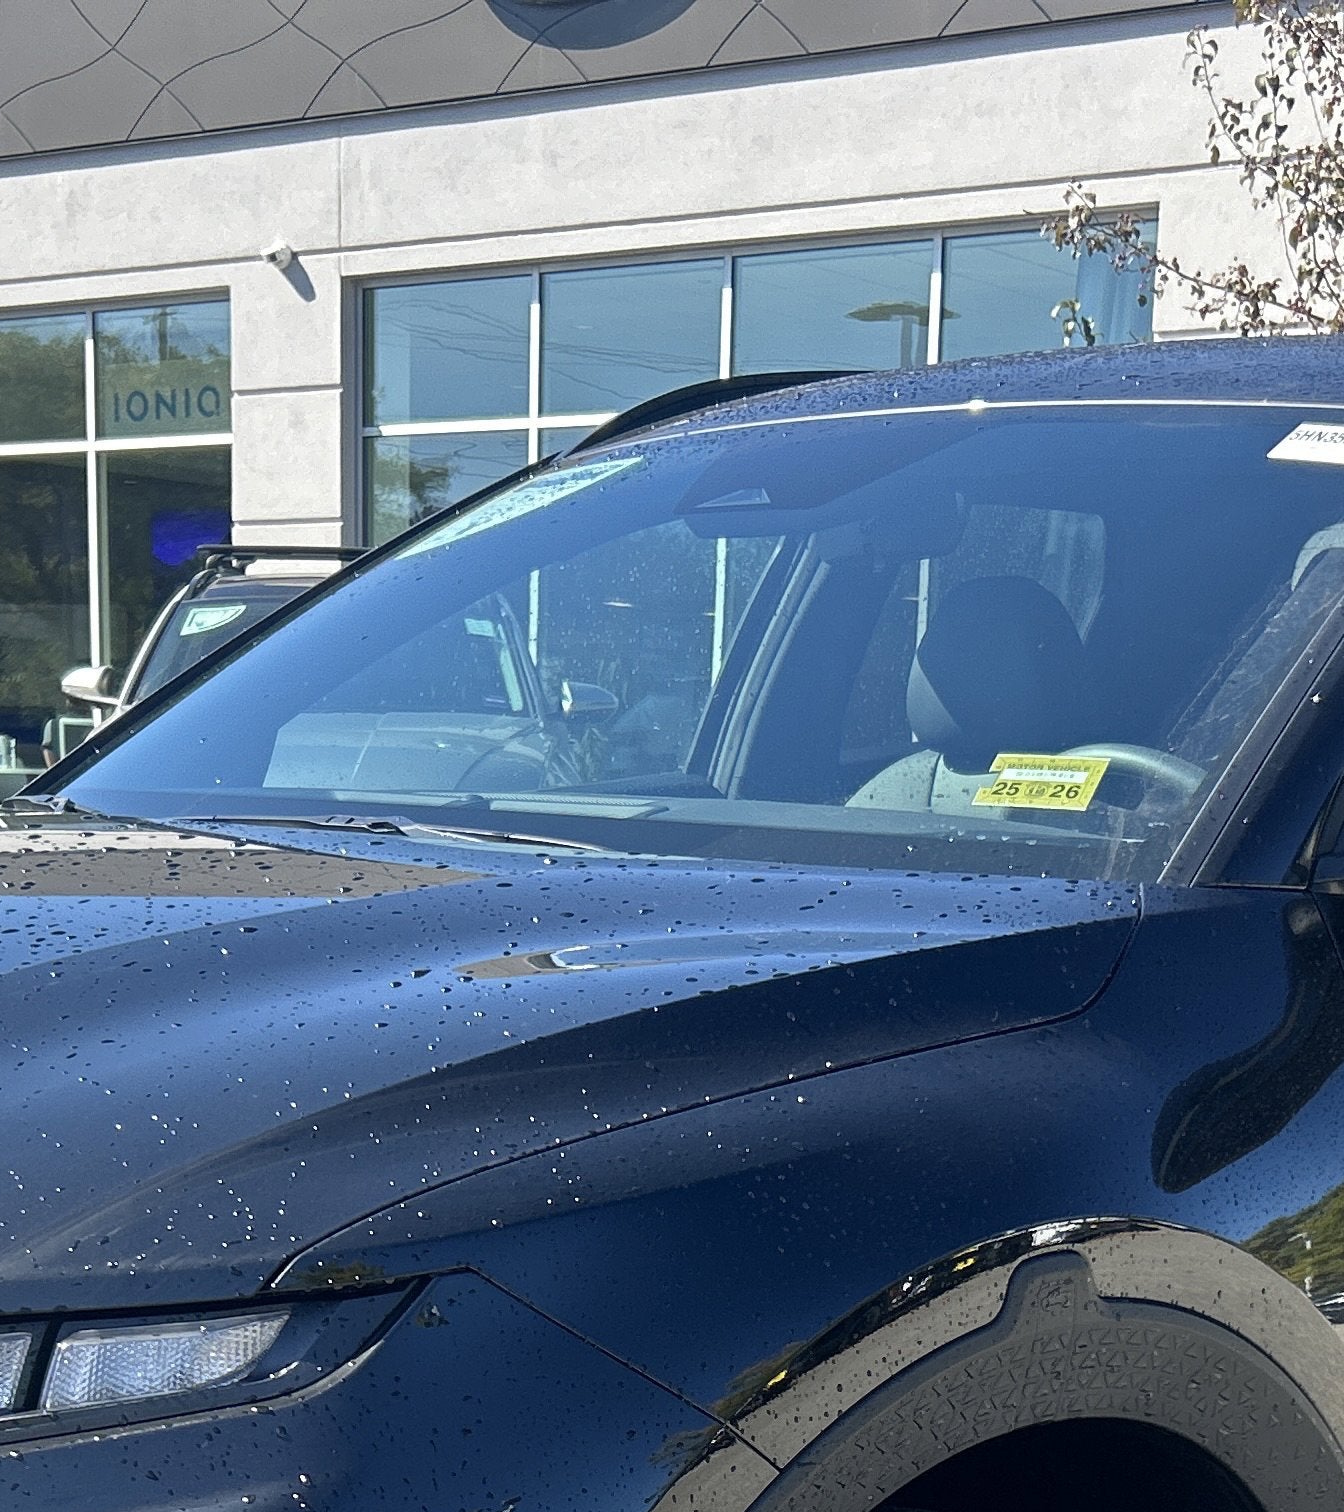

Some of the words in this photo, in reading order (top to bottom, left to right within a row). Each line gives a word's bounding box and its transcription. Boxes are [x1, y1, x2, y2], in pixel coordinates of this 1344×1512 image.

[113, 384, 222, 423] IONIQ
[991, 782, 1022, 796] 25
[1049, 784, 1081, 799] 26
